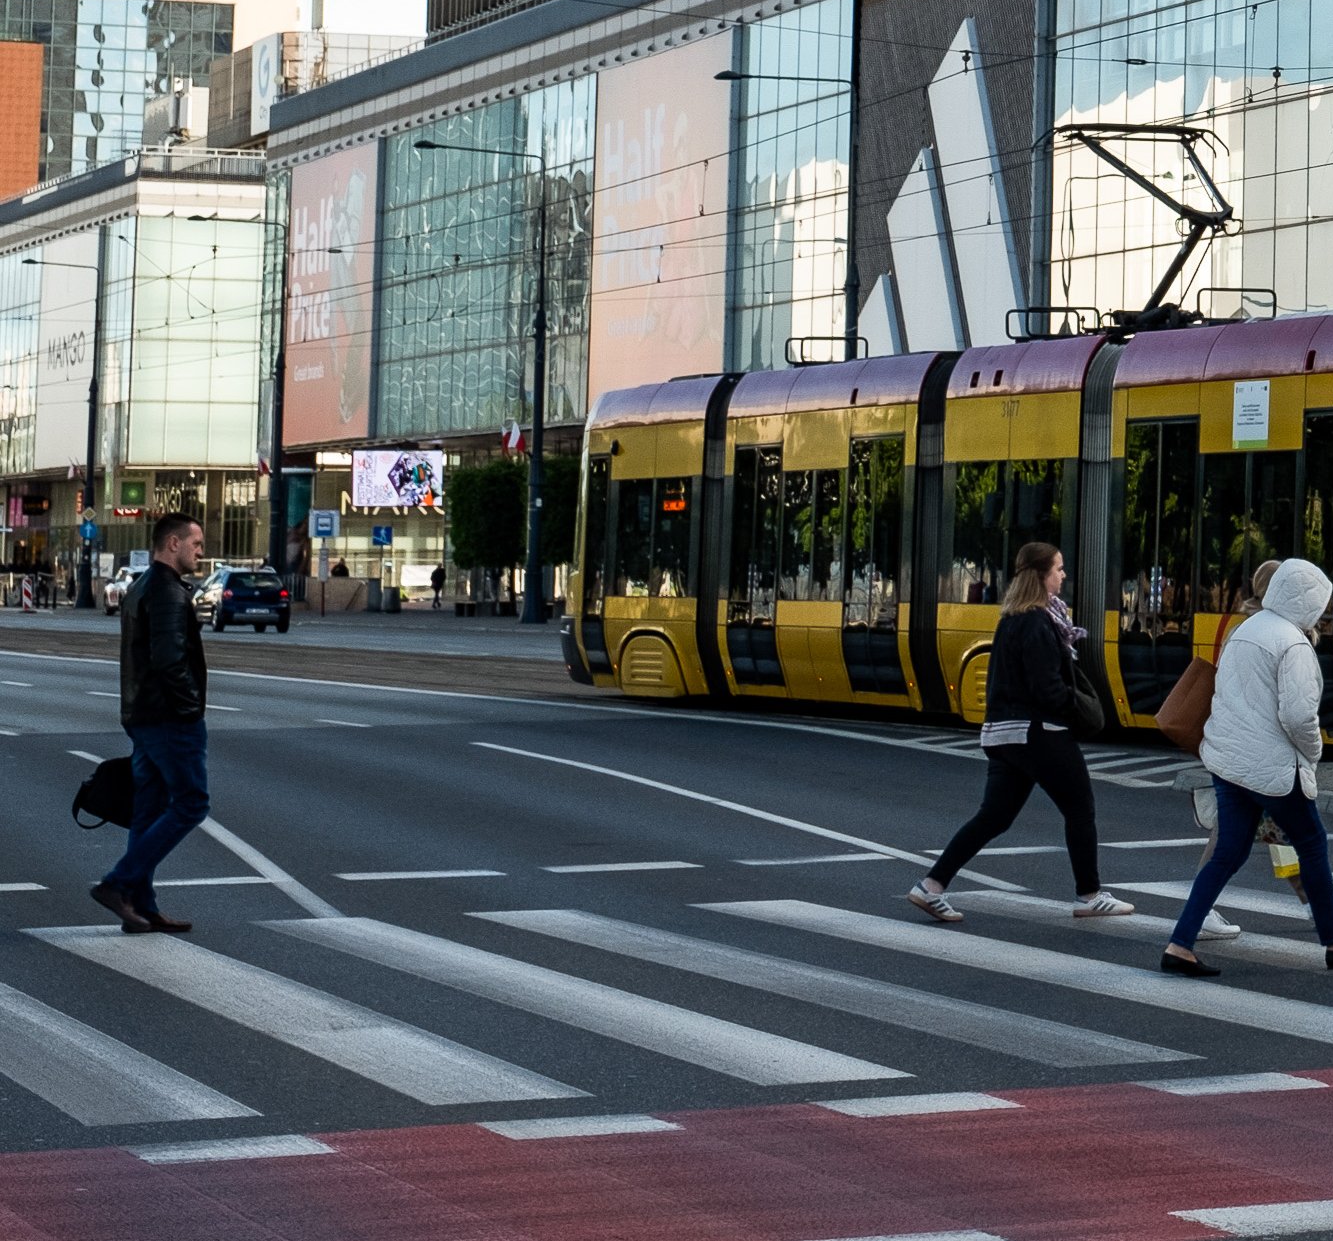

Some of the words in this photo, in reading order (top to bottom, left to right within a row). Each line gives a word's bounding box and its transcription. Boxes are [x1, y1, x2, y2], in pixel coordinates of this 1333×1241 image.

[603, 103, 667, 210] Half
[293, 194, 334, 278] Half
[47, 329, 86, 370] MANGO
[290, 282, 332, 344] Price
